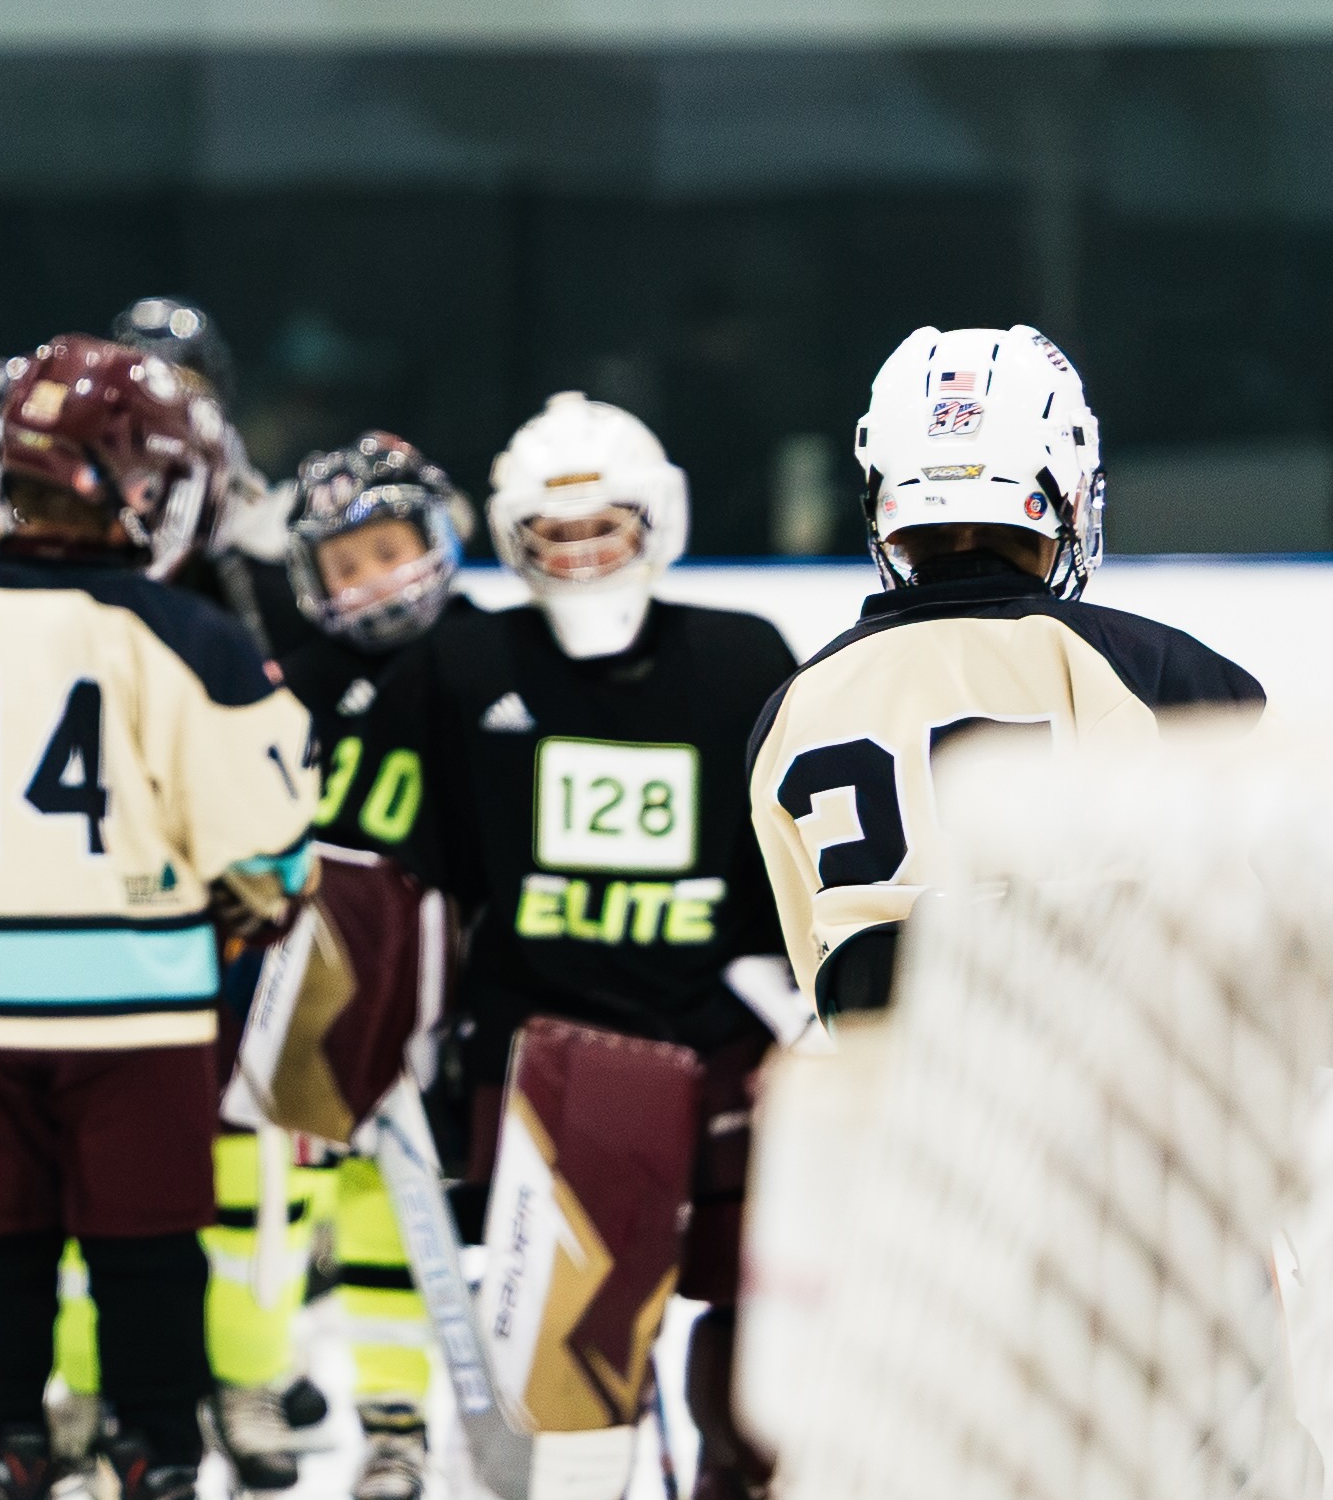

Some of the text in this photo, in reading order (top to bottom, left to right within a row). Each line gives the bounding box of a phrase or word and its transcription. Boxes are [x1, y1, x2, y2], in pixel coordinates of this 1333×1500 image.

[558, 772, 677, 838] 128
[775, 714, 1055, 892] 2
[514, 872, 727, 946] ELITE
